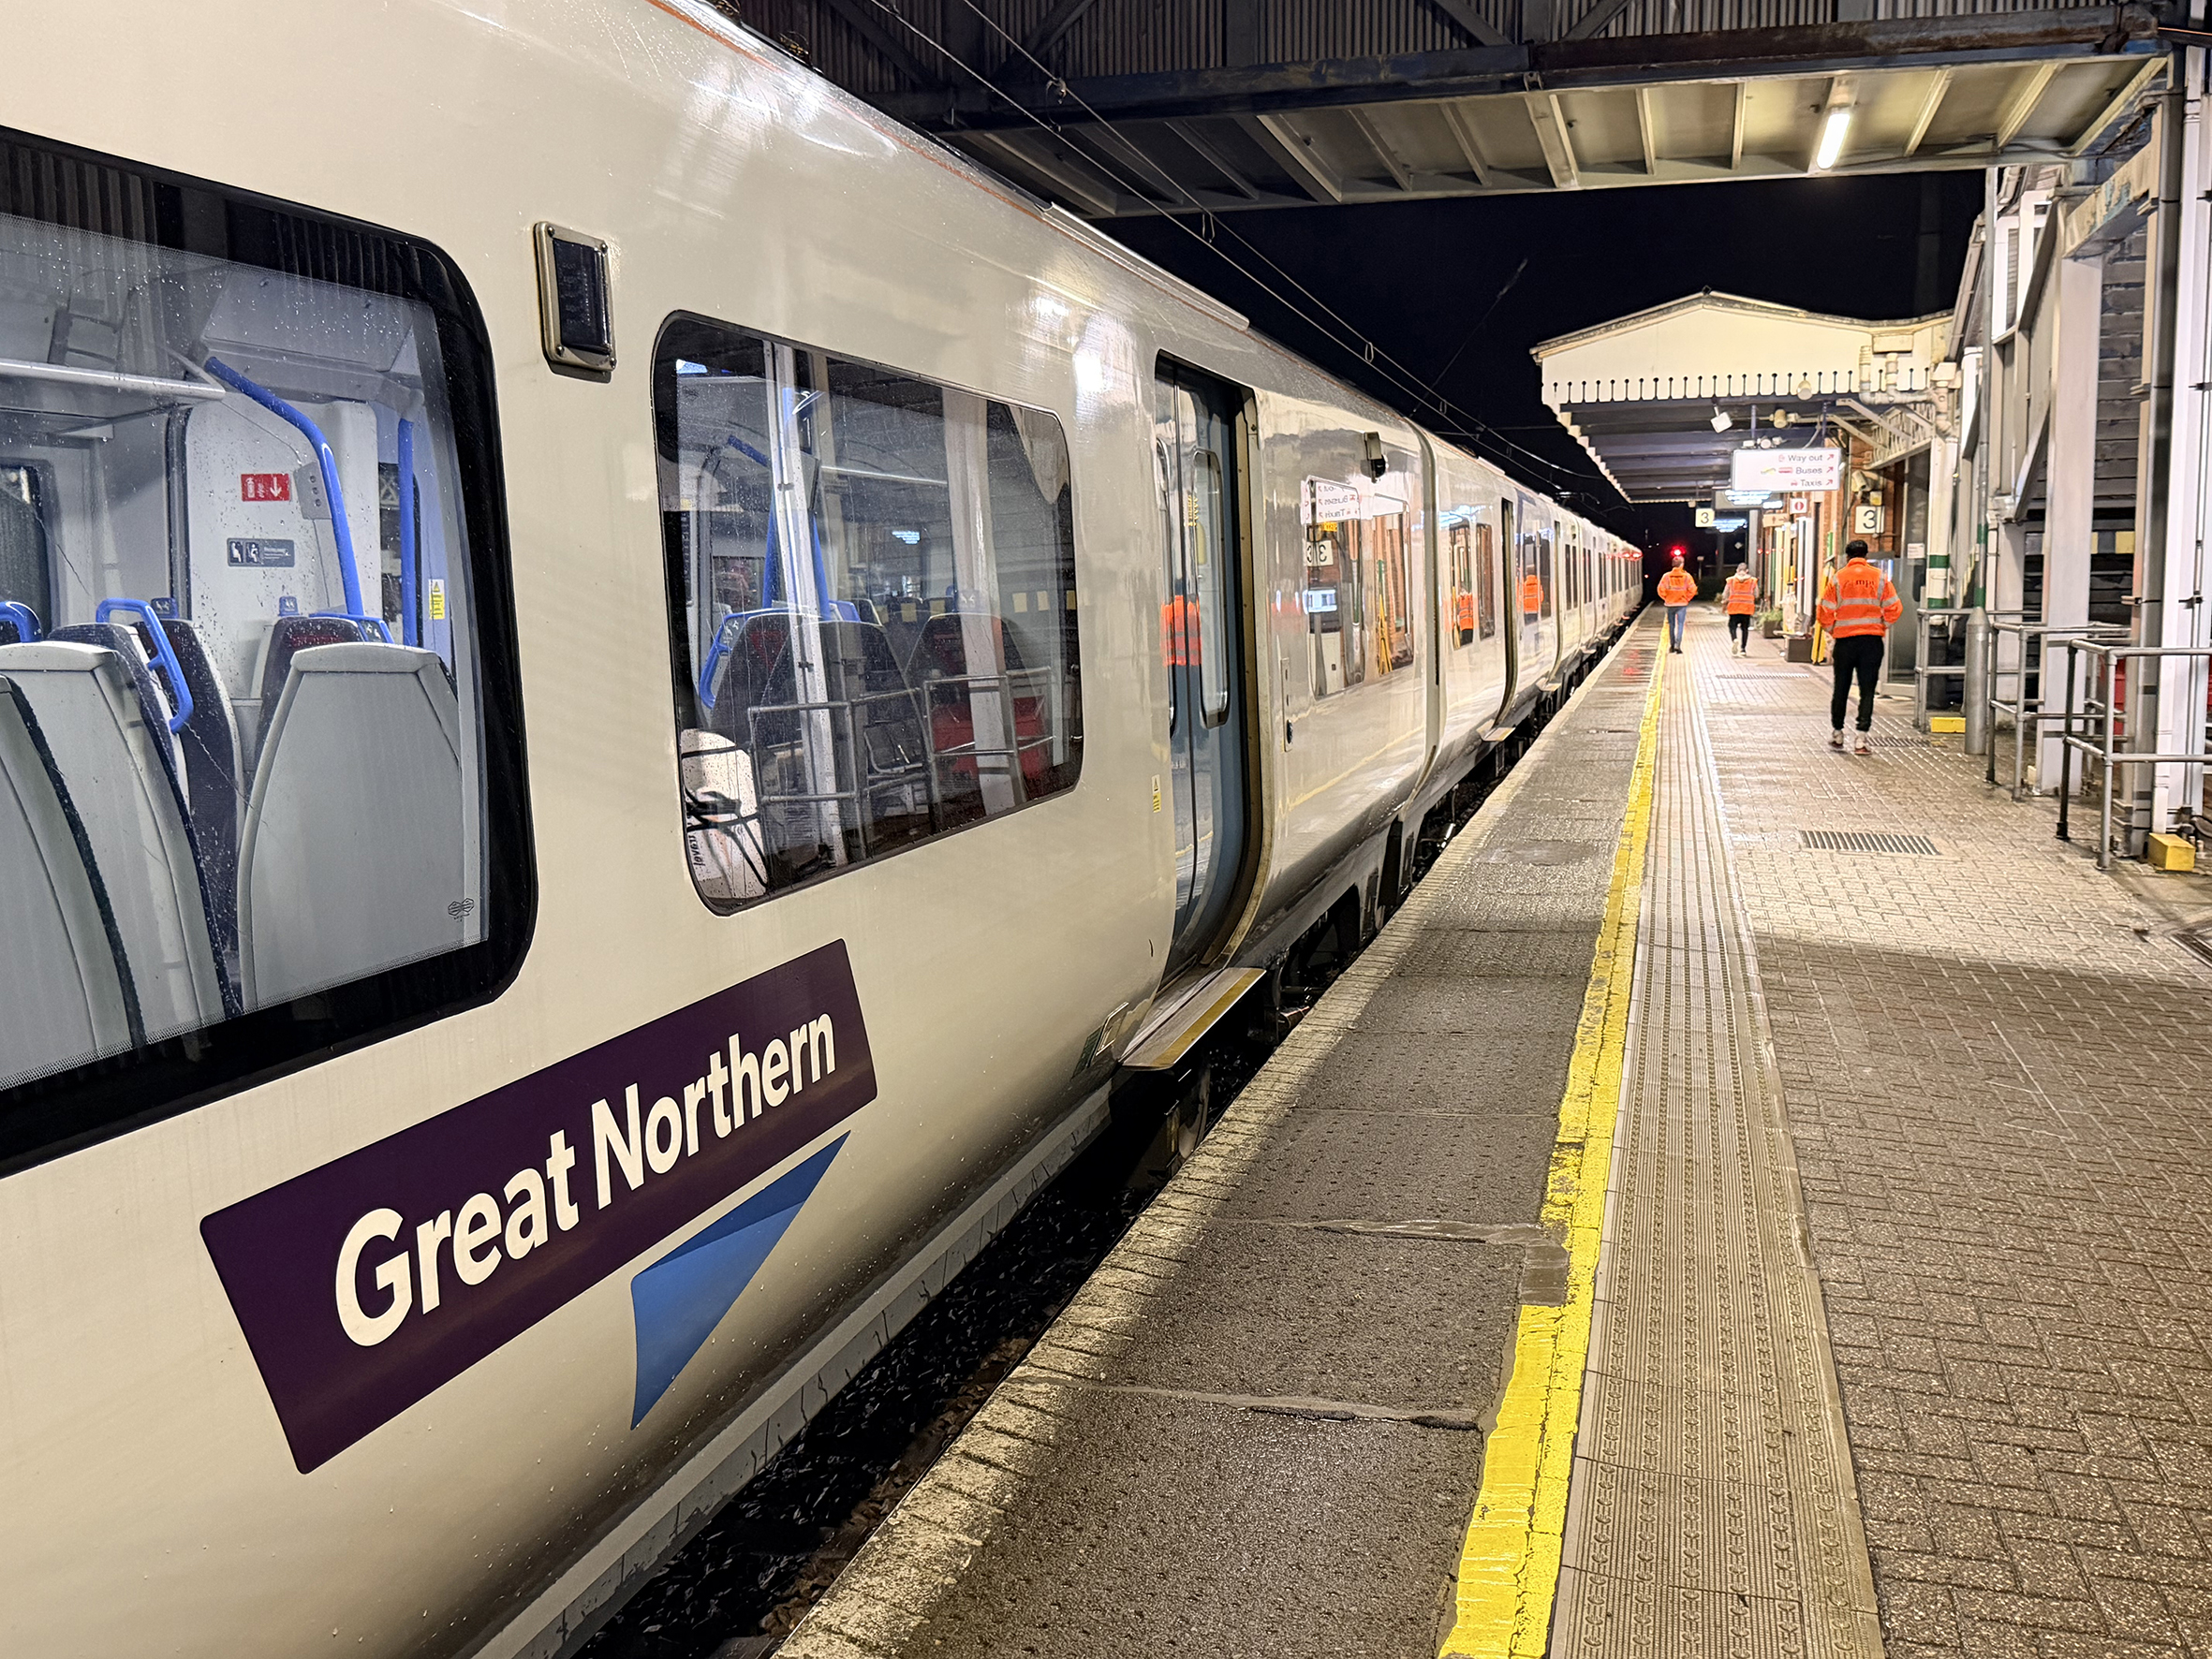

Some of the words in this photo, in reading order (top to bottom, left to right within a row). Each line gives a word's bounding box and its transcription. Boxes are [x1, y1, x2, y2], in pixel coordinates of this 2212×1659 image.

[1788, 454, 1806, 462] Way
[1701, 512, 1709, 523] 3
[1863, 510, 1877, 529] 3
[335, 1129, 580, 1346] Great
[591, 1012, 837, 1211] Northern
